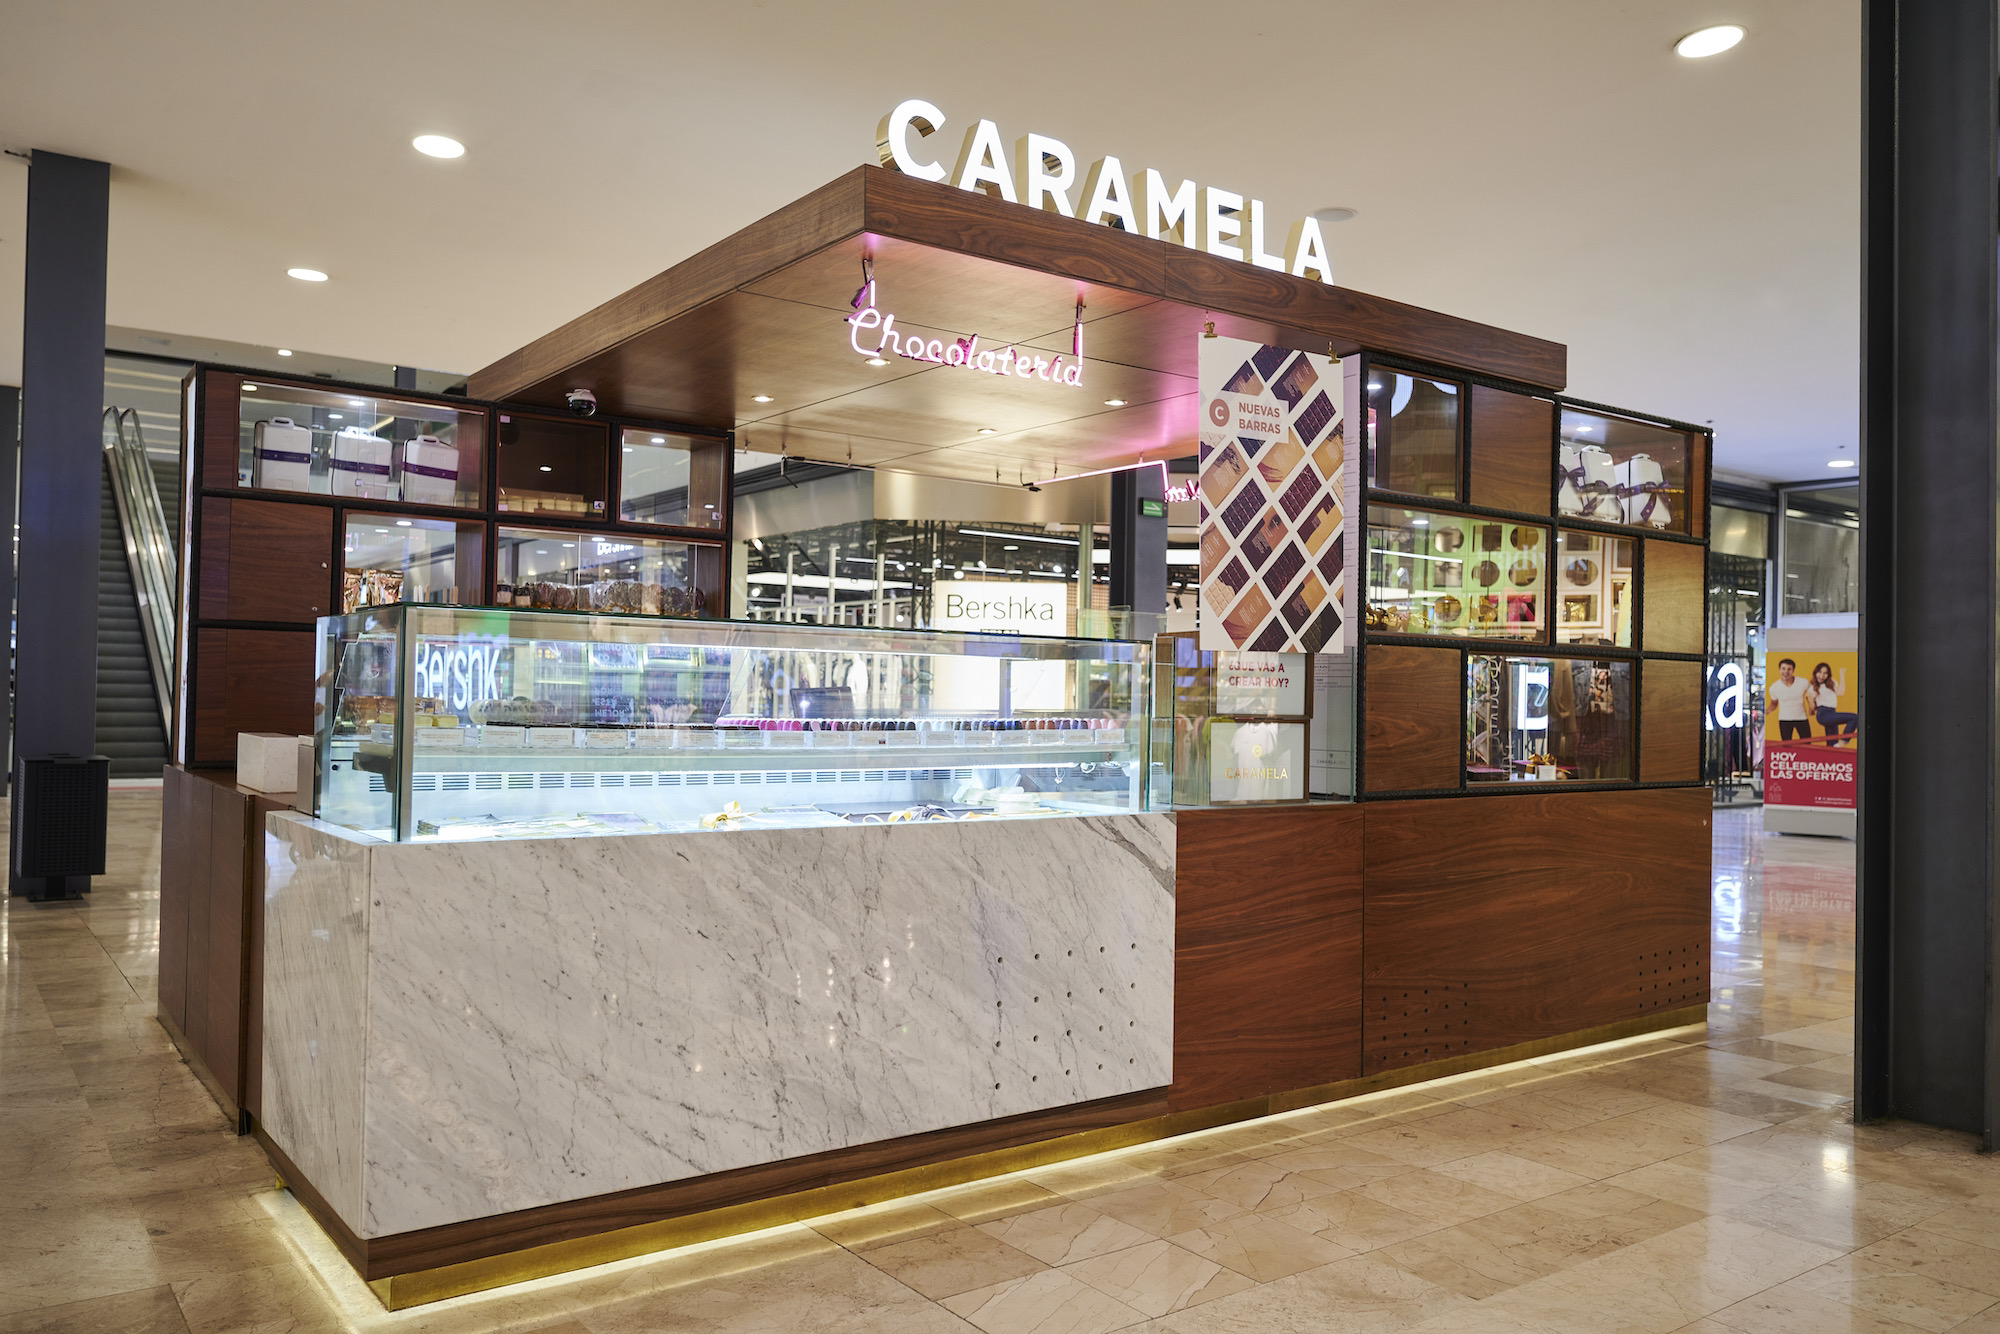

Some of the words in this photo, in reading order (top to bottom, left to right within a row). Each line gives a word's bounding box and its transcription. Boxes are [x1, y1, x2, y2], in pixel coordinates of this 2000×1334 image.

[878, 99, 1334, 285] CARAMELA
[1238, 402, 1281, 418] NUEVAS
[1238, 418, 1281, 435] BARRAS
[947, 594, 1054, 621] Bershka
[1256, 661, 1276, 673] VAS
[1278, 662, 1285, 673] A
[1228, 676, 1262, 687] CREAR
[1264, 677, 1289, 688] HOY?
[1770, 752, 1797, 762] HOY
[1770, 761, 1854, 773] CELEBRAMOS
[1225, 767, 1289, 780] CARAMELA
[1770, 770, 1794, 779] LAS
[1795, 771, 1853, 782] OFERTAS
